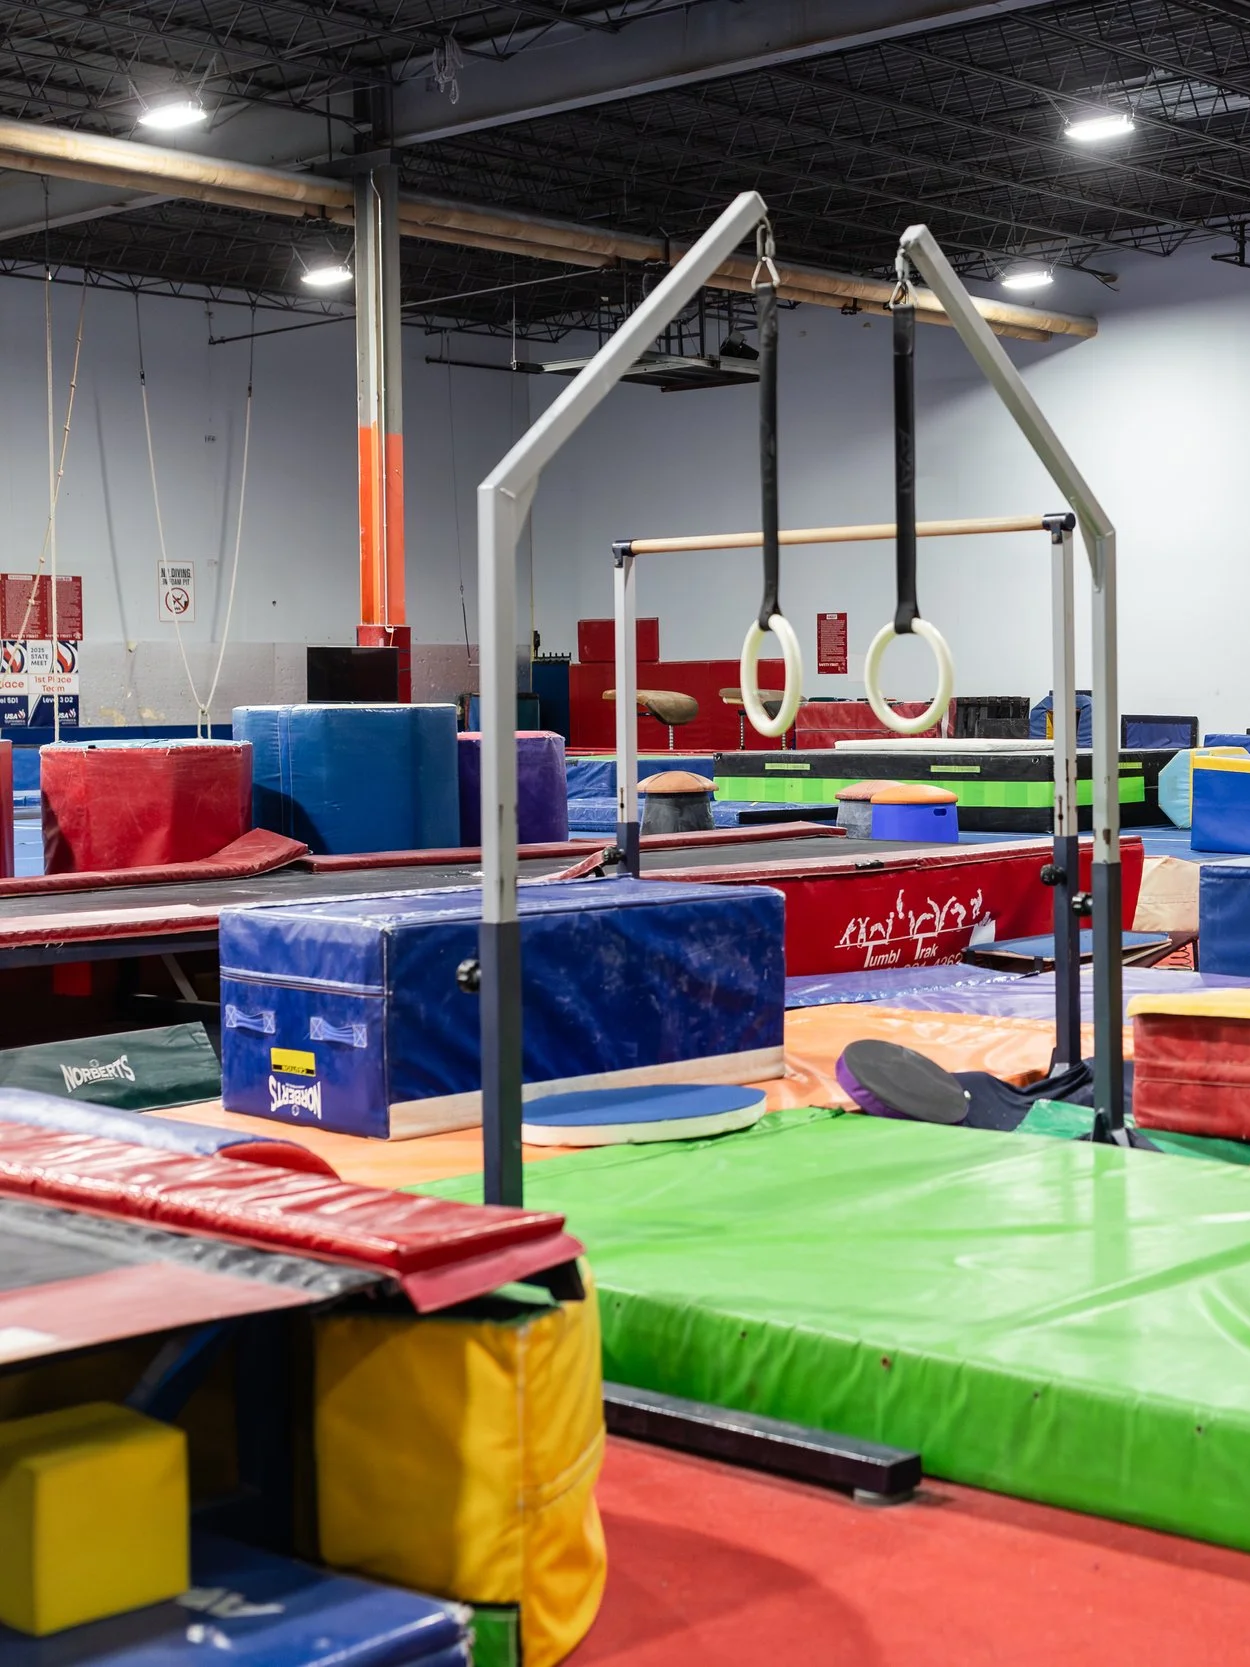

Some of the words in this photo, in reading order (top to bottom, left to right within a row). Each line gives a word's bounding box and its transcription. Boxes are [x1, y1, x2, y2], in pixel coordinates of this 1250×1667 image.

[171, 568, 191, 578] DIVING
[861, 939, 901, 968] Tumbl
[911, 932, 939, 960] Trak
[60, 1055, 136, 1093] NORBERTS
[268, 1075, 322, 1120] NORBERTS
